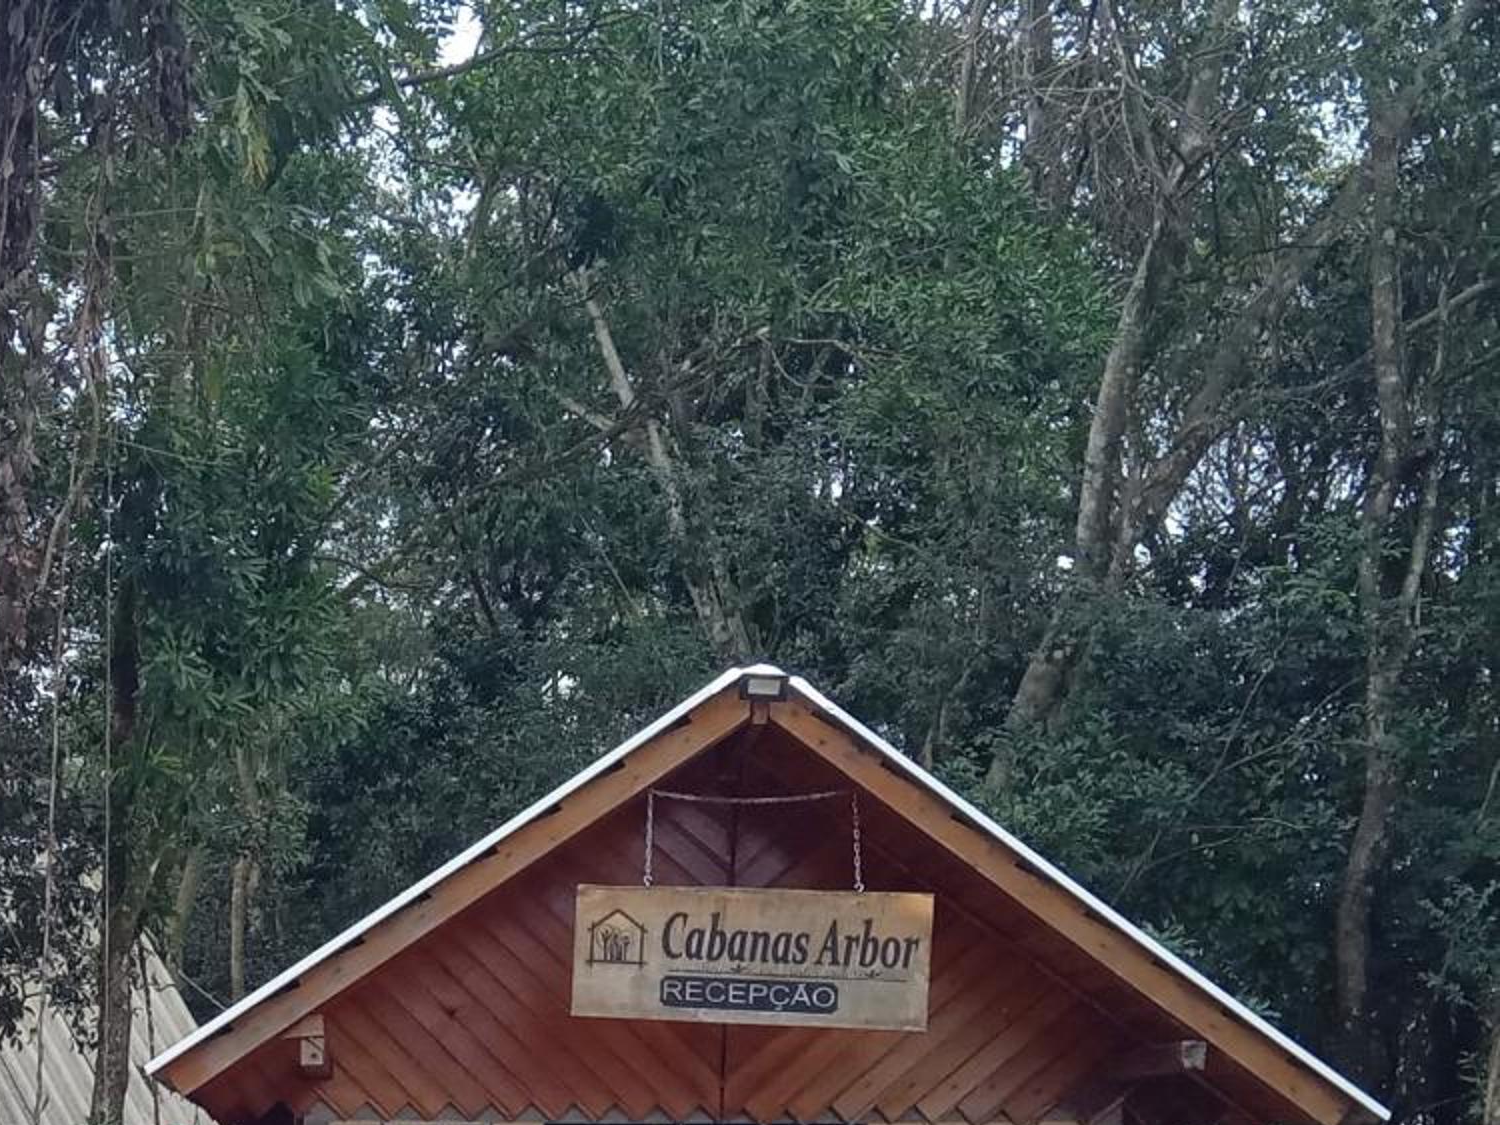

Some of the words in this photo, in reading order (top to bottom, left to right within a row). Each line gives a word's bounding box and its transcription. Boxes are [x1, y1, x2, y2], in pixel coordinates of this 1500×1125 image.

[661, 911, 811, 965] Cabanas
[814, 918, 920, 968] Arbor
[663, 980, 836, 1010] RECEPÇÃO
